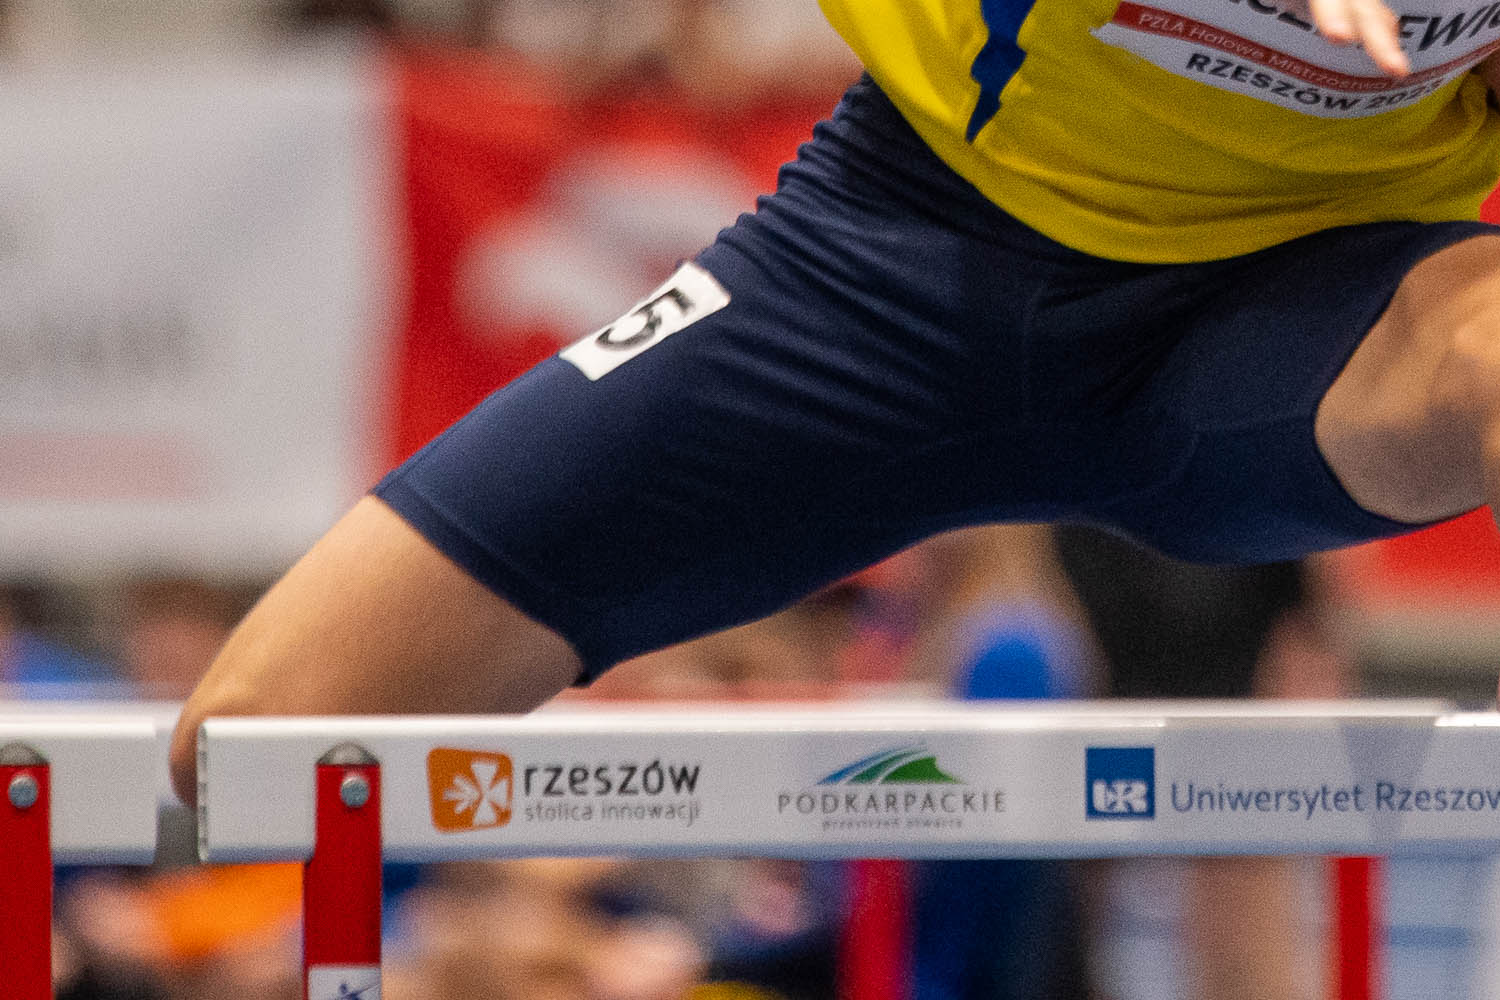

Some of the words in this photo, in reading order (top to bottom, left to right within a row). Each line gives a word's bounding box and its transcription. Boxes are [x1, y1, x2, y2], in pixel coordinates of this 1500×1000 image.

[1138, 13, 1185, 34] PZLA
[1188, 27, 1263, 60] Halowe
[1186, 52, 1363, 111] RZESZÓW
[595, 288, 695, 350] 5
[524, 760, 700, 796] rzeszów
[525, 802, 593, 821] stolica
[602, 802, 700, 827] innowacji
[777, 792, 1006, 814] PODKARPACKIE
[1171, 781, 1365, 820] Uniwersytet
